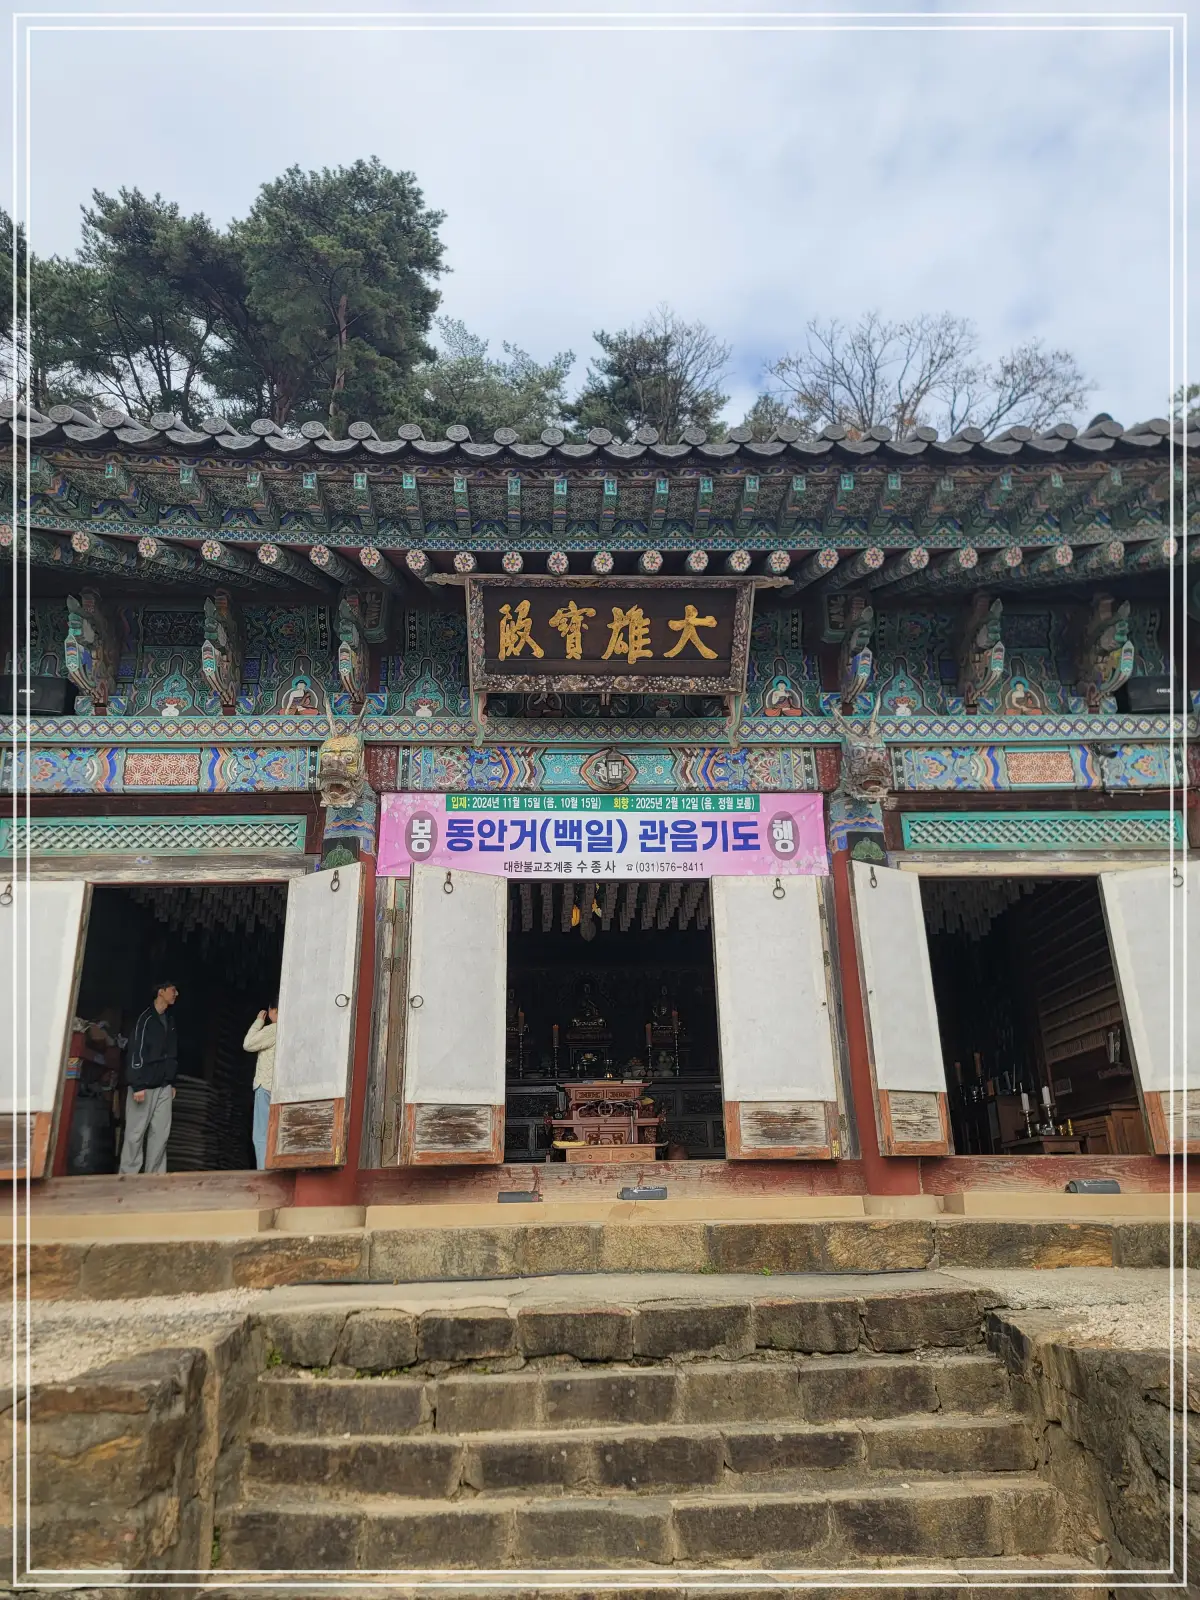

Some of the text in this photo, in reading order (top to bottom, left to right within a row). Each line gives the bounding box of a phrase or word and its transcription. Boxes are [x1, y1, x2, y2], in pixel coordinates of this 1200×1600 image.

[451, 796, 601, 810] 입재: 2024년 11월 15일 (음. 10월 15일)
[635, 796, 663, 809] 2025년
[665, 796, 679, 809] 2월
[681, 796, 699, 810] 12일
[701, 796, 715, 810] (음.
[718, 796, 734, 810] 정월
[736, 796, 755, 810] 보름)
[411, 818, 795, 854] 봉 동안거(백일) 관음기도 행
[503, 860, 573, 874] 대한불교조계종
[635, 861, 705, 874] (031)576-8411
